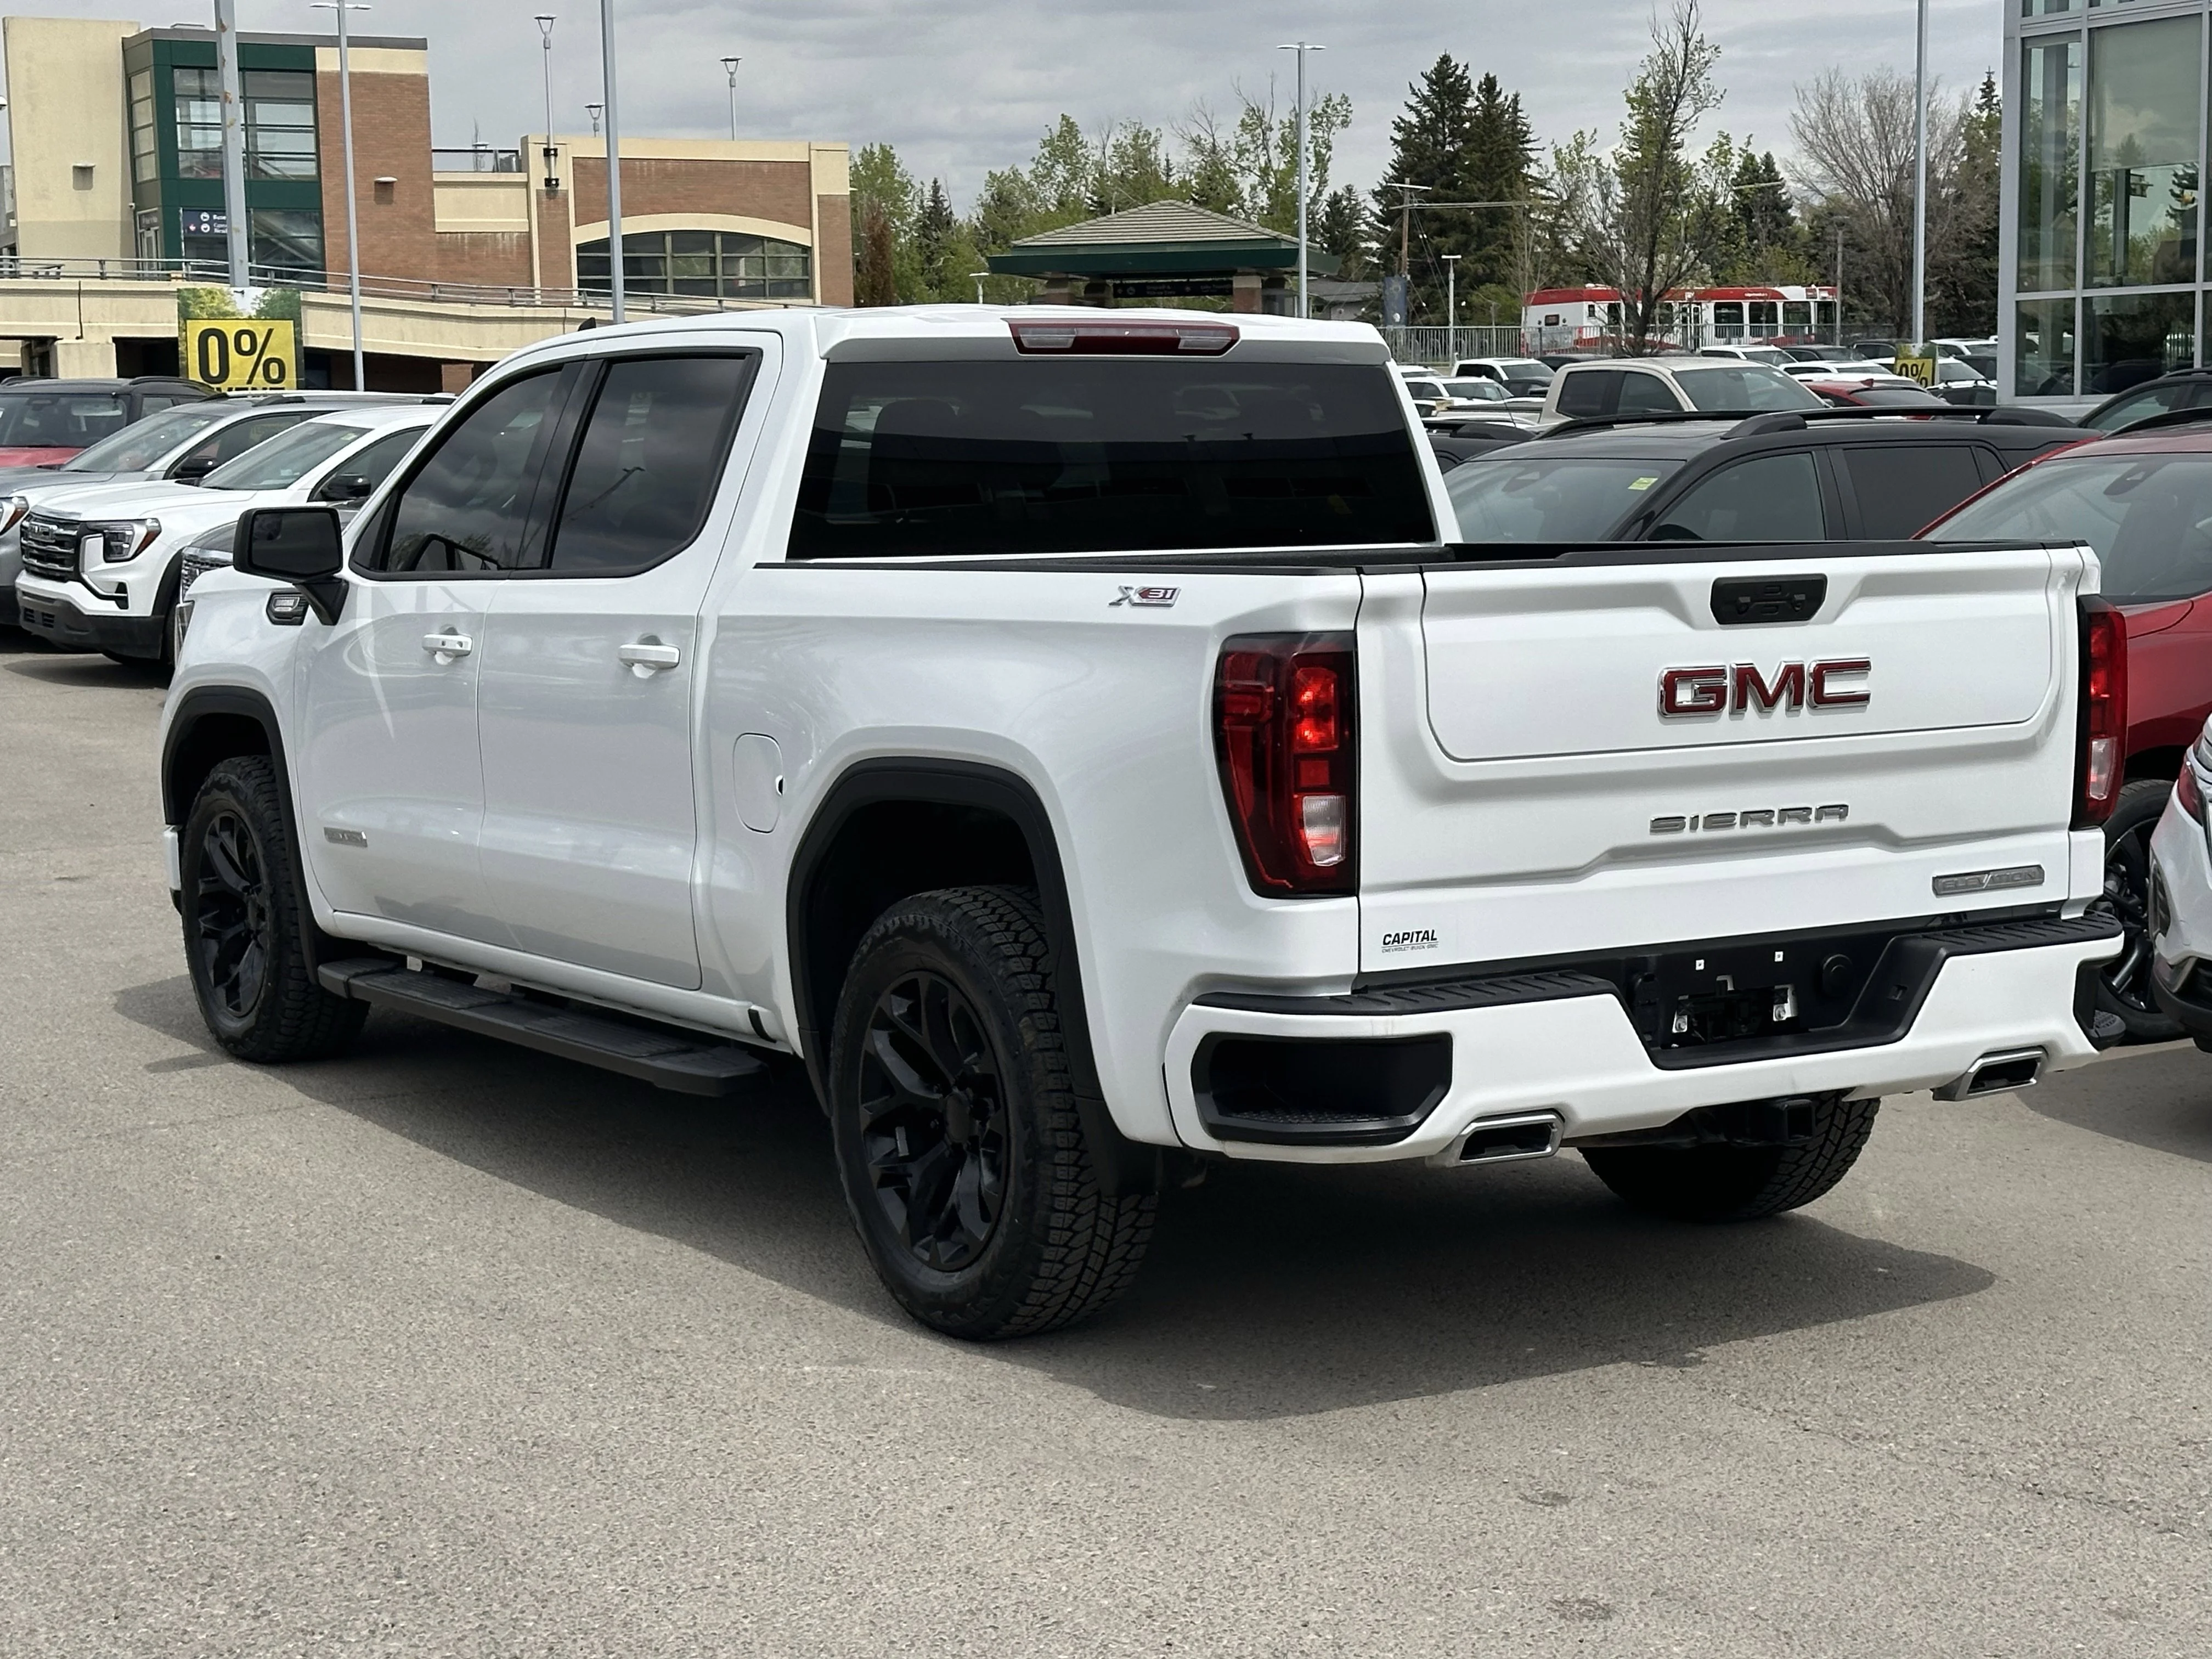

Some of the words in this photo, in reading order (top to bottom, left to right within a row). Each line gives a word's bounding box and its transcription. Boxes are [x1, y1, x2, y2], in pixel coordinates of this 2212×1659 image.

[198, 328, 286, 385] 0%
[1108, 585, 1181, 607] X31
[1657, 656, 1872, 718] GMC
[1650, 803, 1849, 834] SIERRA
[1940, 871, 2039, 891] ELEVATION
[1383, 929, 1437, 945] CAPITAL
